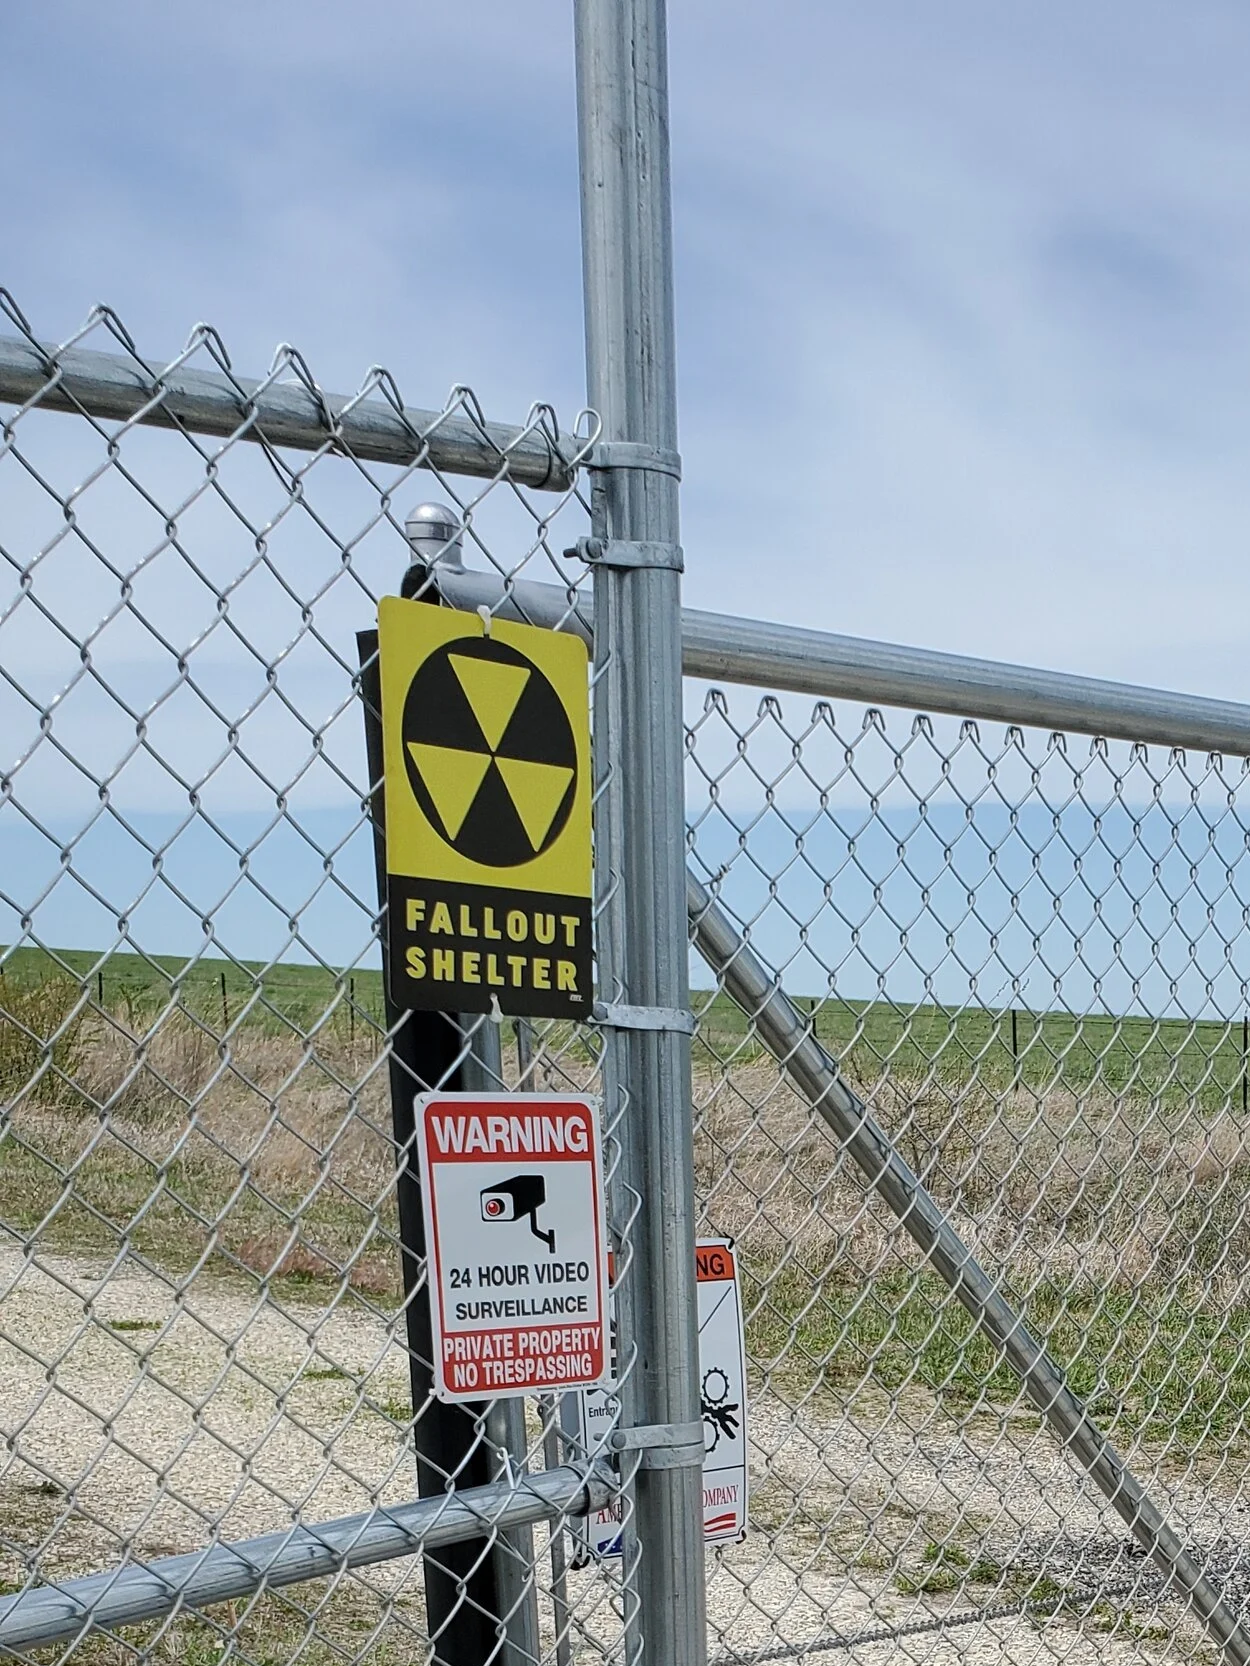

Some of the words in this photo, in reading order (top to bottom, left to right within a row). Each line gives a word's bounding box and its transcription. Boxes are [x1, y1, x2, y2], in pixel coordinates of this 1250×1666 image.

[406, 898, 581, 948] FALLOUT
[405, 946, 578, 992] SHELTER
[431, 1115, 588, 1154] WARNING
[450, 1267, 472, 1289] 24
[478, 1264, 529, 1288] HOUR
[534, 1261, 590, 1285] VIDEO
[455, 1295, 588, 1321] SURVEILLANCE
[443, 1333, 515, 1363] PRIVATE
[518, 1326, 601, 1356] PROPERTY
[453, 1362, 479, 1388] NO
[482, 1352, 593, 1386] TRESPASSING
[702, 1484, 739, 1508] OMPANY
